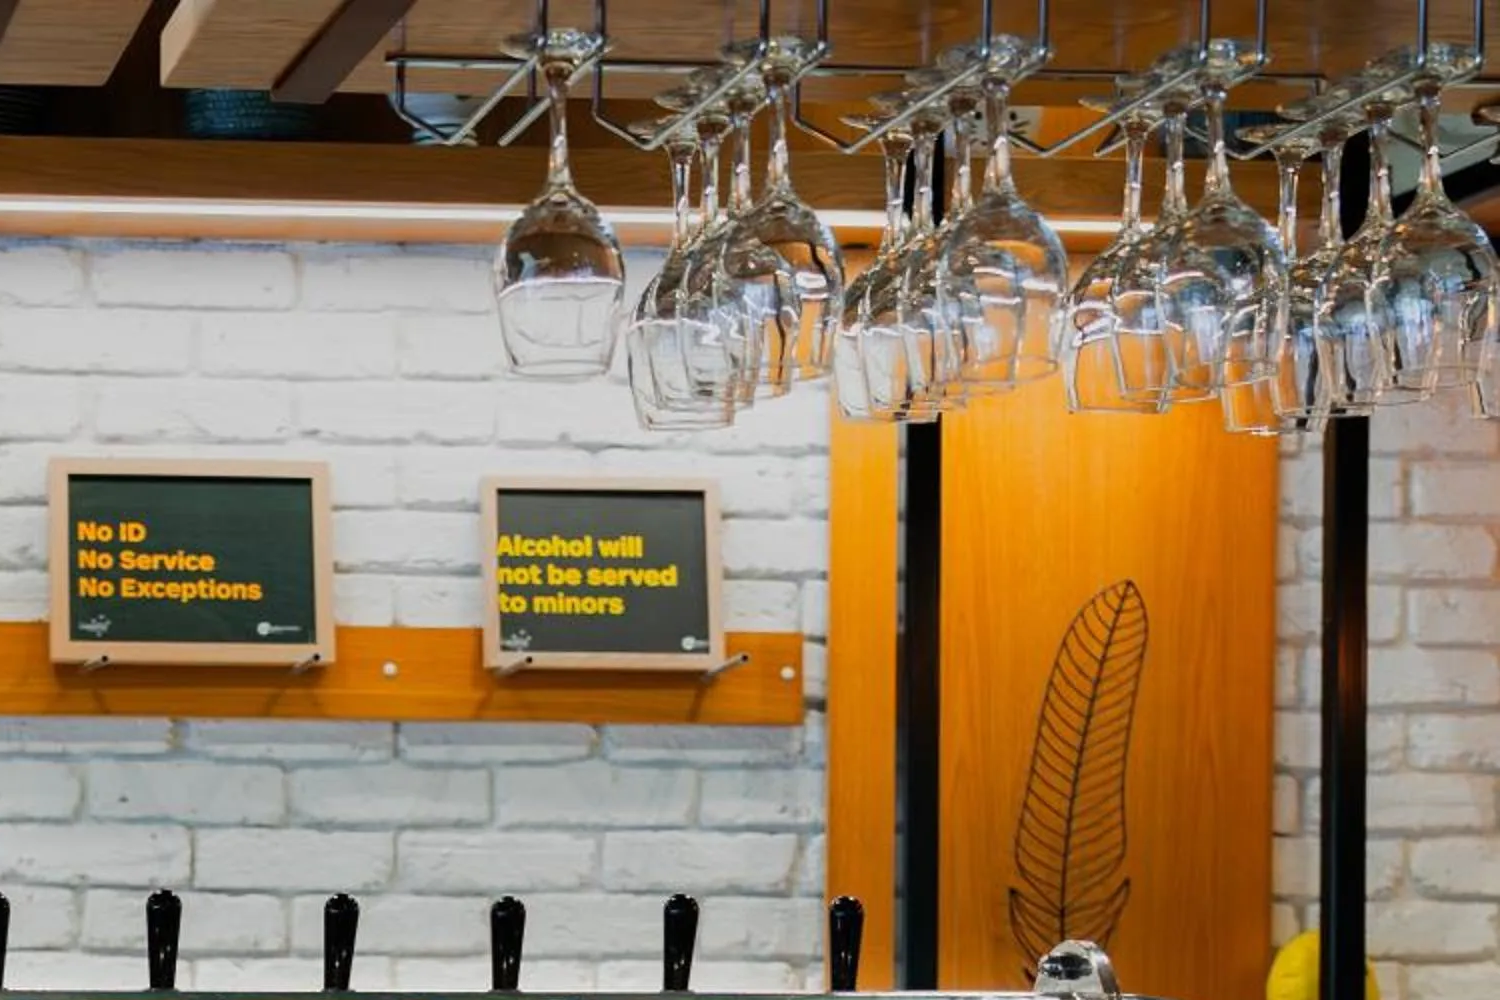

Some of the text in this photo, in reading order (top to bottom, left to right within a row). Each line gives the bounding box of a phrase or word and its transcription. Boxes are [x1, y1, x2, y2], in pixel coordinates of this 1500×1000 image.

[77, 521, 147, 542] No ID
[498, 534, 643, 558] Alcohol will
[78, 549, 216, 571] No Service
[497, 564, 678, 587] not be served
[78, 577, 263, 603] No Exceptions
[499, 592, 625, 615] to minors
